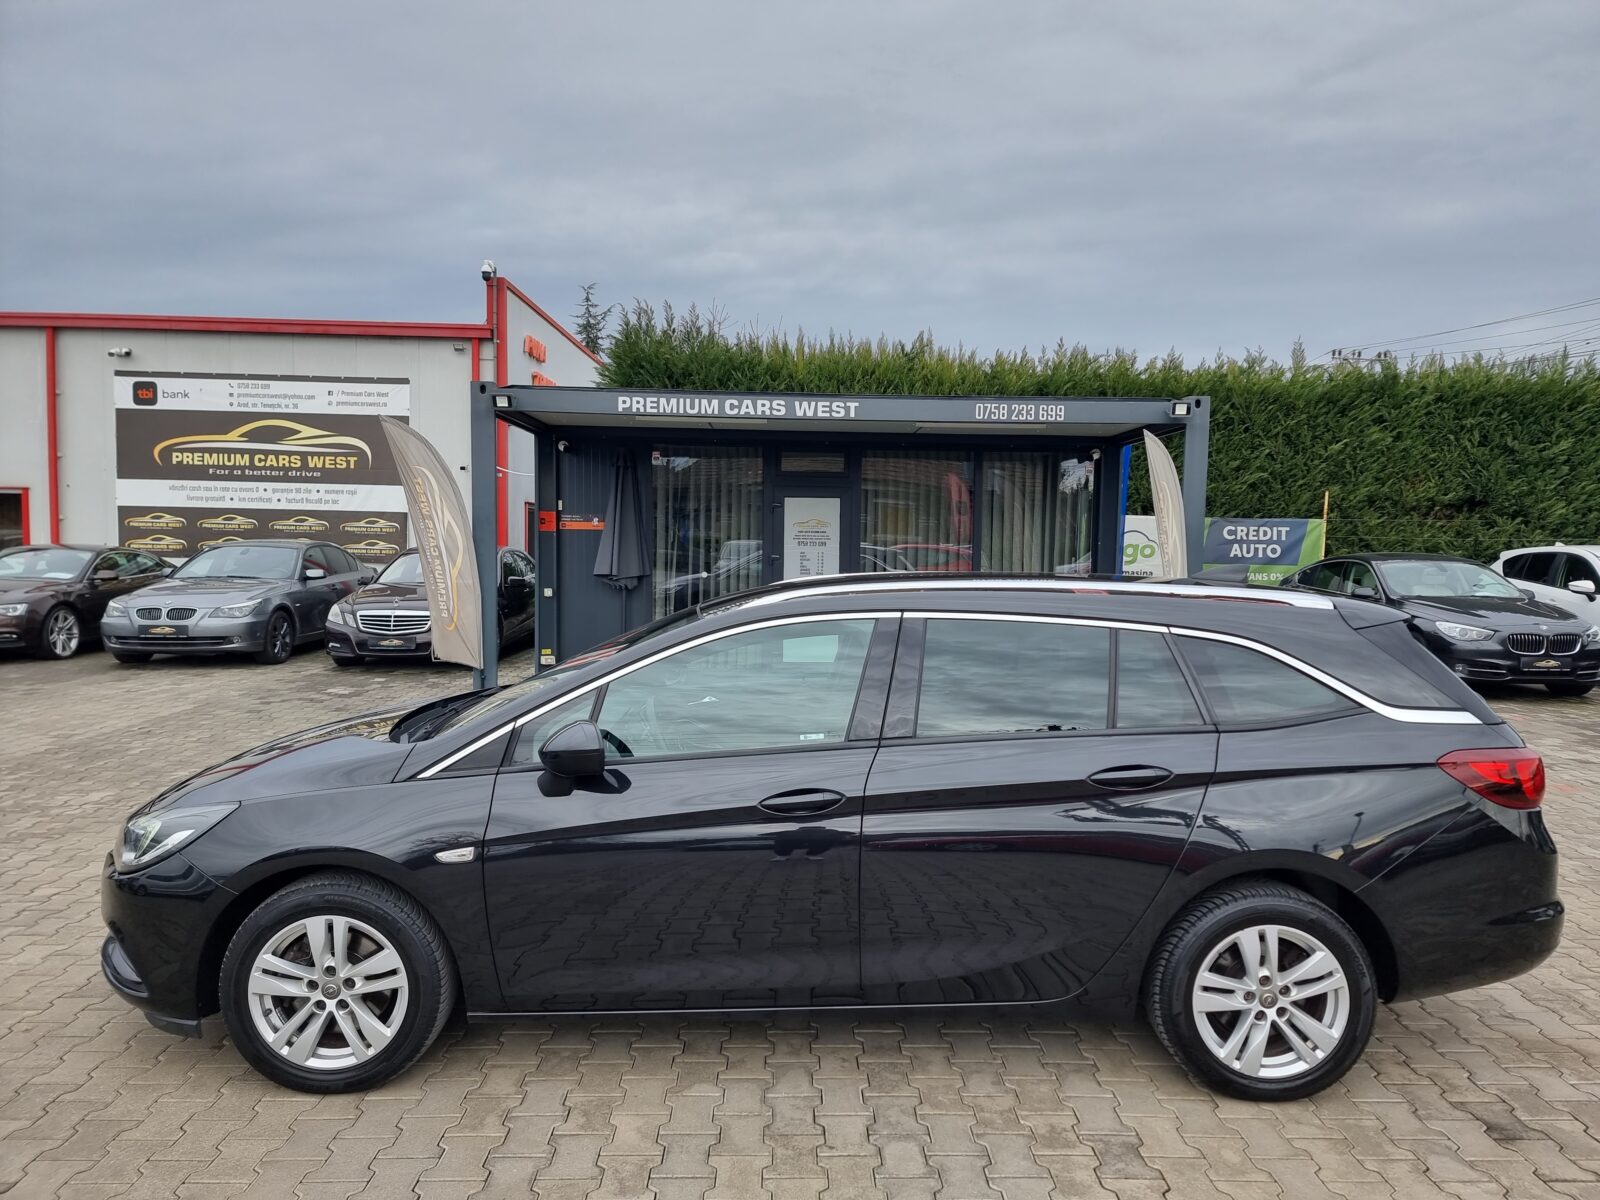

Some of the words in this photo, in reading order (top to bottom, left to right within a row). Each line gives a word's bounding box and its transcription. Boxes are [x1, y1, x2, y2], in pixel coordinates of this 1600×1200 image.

[137, 388, 153, 398] tbi
[162, 390, 190, 398] bank
[618, 396, 719, 415] PREMIUM
[724, 400, 786, 416] CARS
[794, 401, 860, 417] WEST
[976, 404, 1007, 420] 0758
[1012, 404, 1035, 420] 233
[1039, 405, 1064, 420] 699
[172, 452, 250, 466] PREMIUM
[254, 454, 301, 467] CARS
[307, 455, 357, 468] WEST
[1223, 525, 1290, 541] CREDIT
[1230, 544, 1281, 558] AUTO
[1247, 572, 1268, 580] ANS
